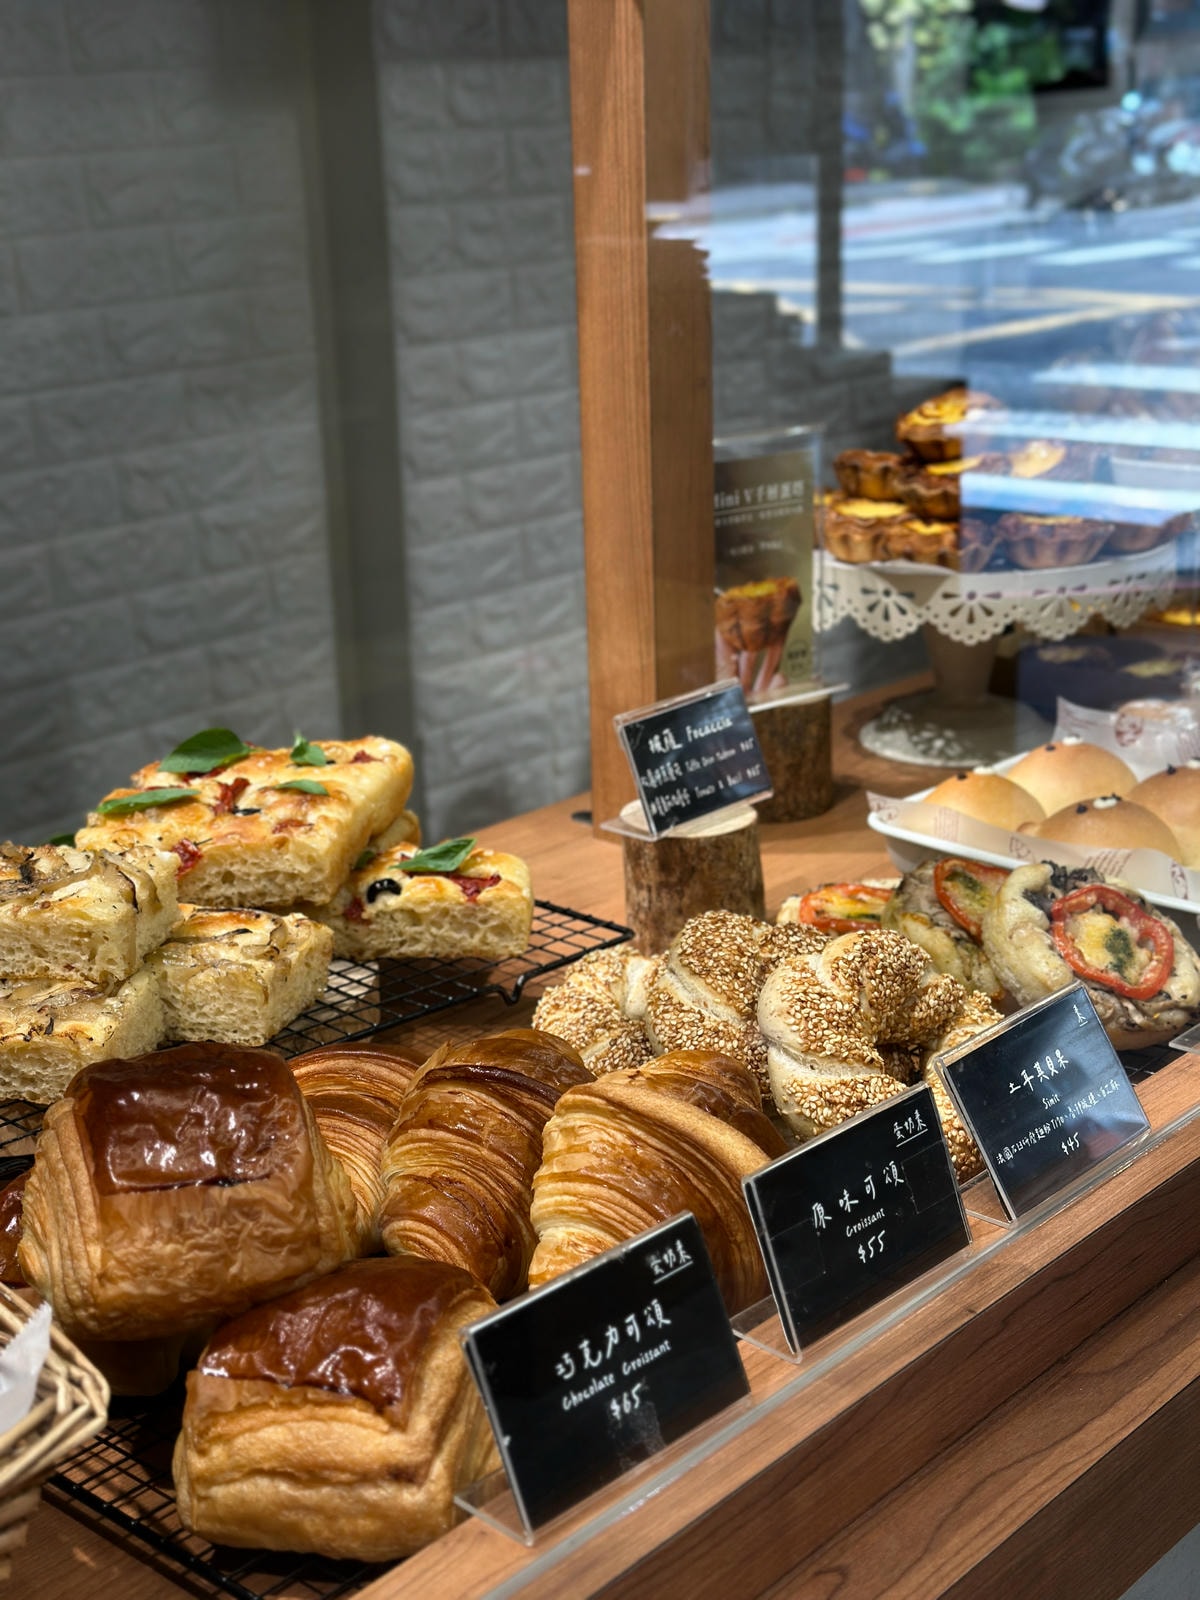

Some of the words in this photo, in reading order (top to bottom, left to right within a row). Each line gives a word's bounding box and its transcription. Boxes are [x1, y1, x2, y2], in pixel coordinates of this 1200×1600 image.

[1007, 1048, 1070, 1094] 土耳其貝果
[1042, 1093, 1061, 1110] Simit
[893, 1109, 927, 1140] 蛋奶素
[1060, 1132, 1081, 1156] $45
[812, 1160, 905, 1229] 原味可頌
[845, 1207, 886, 1237] Croissant
[857, 1230, 886, 1263] $55
[555, 1298, 672, 1380] 巧克力可頌
[562, 1373, 615, 1411] Chocolate
[622, 1339, 672, 1376] Croissant
[610, 1382, 643, 1420] $65
